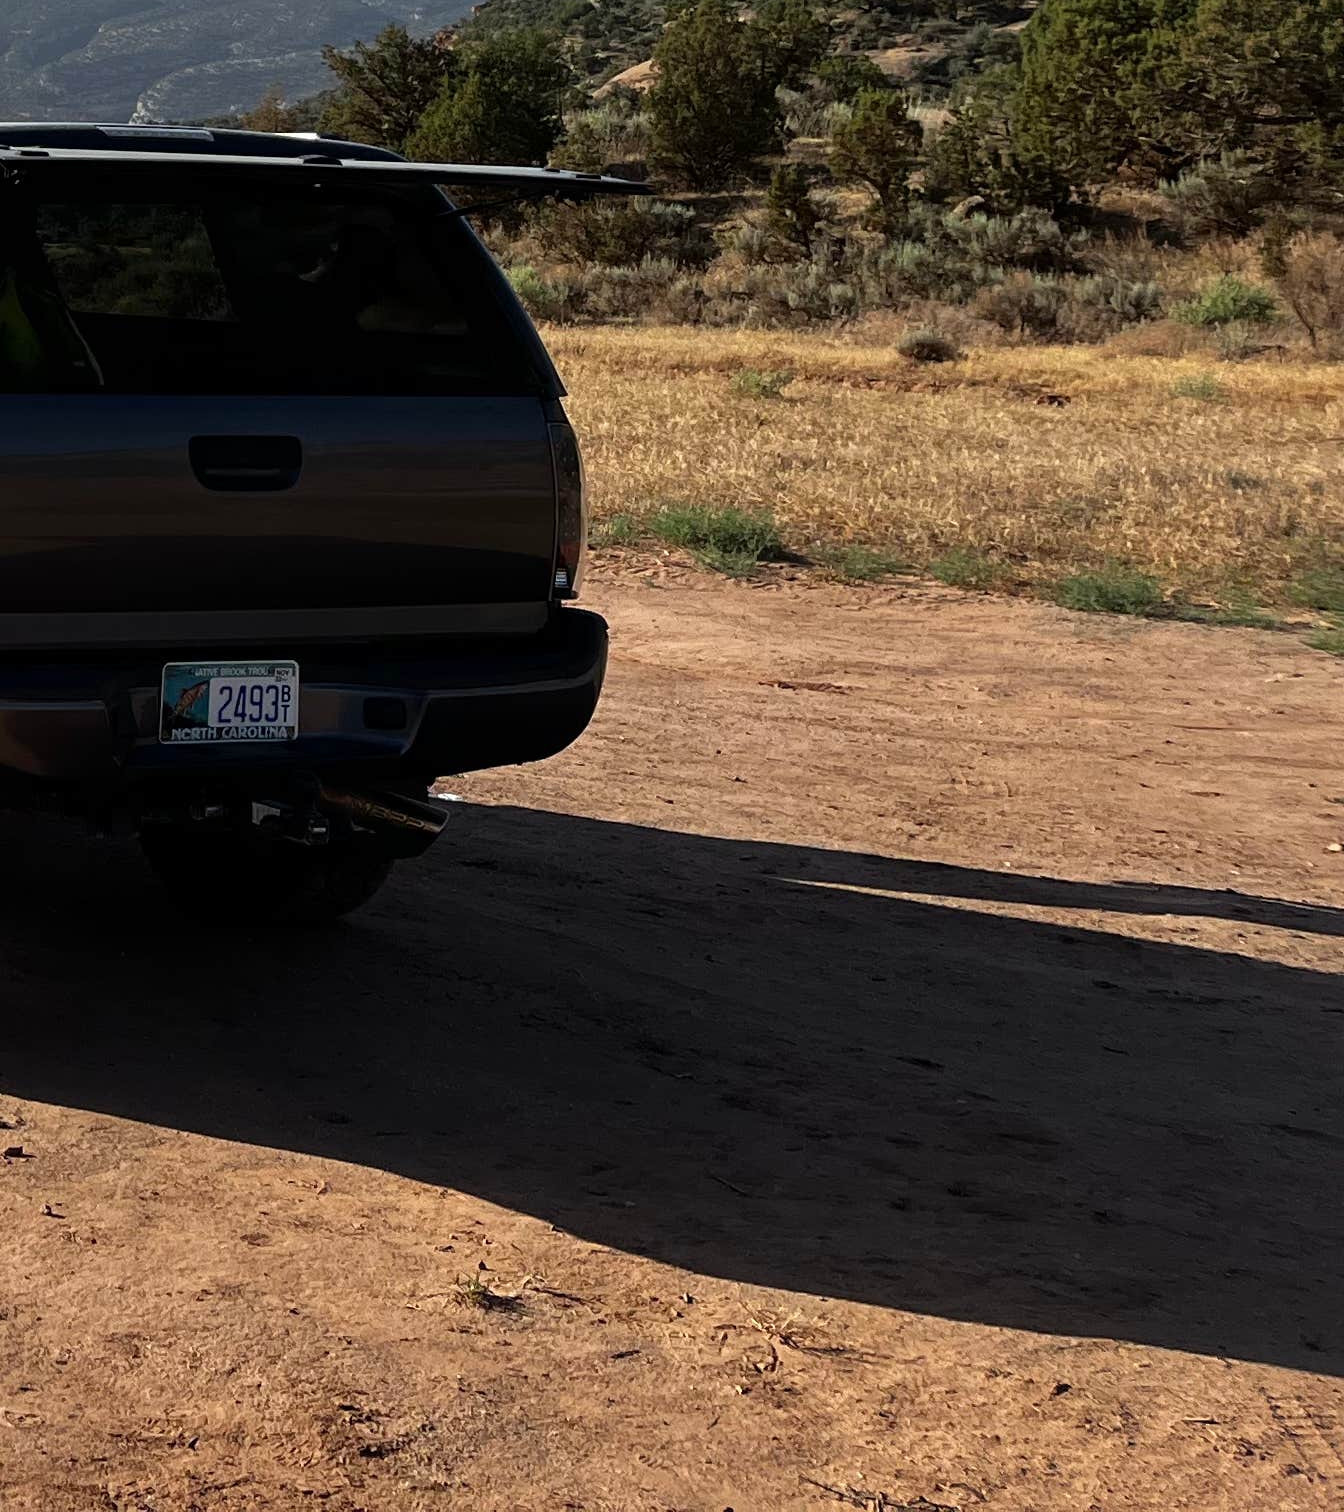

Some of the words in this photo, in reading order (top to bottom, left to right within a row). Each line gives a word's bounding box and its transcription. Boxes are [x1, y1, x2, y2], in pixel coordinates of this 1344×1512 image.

[218, 685, 279, 723] 2493
[171, 727, 217, 740] NORTH
[222, 727, 288, 739] CAROLINA
